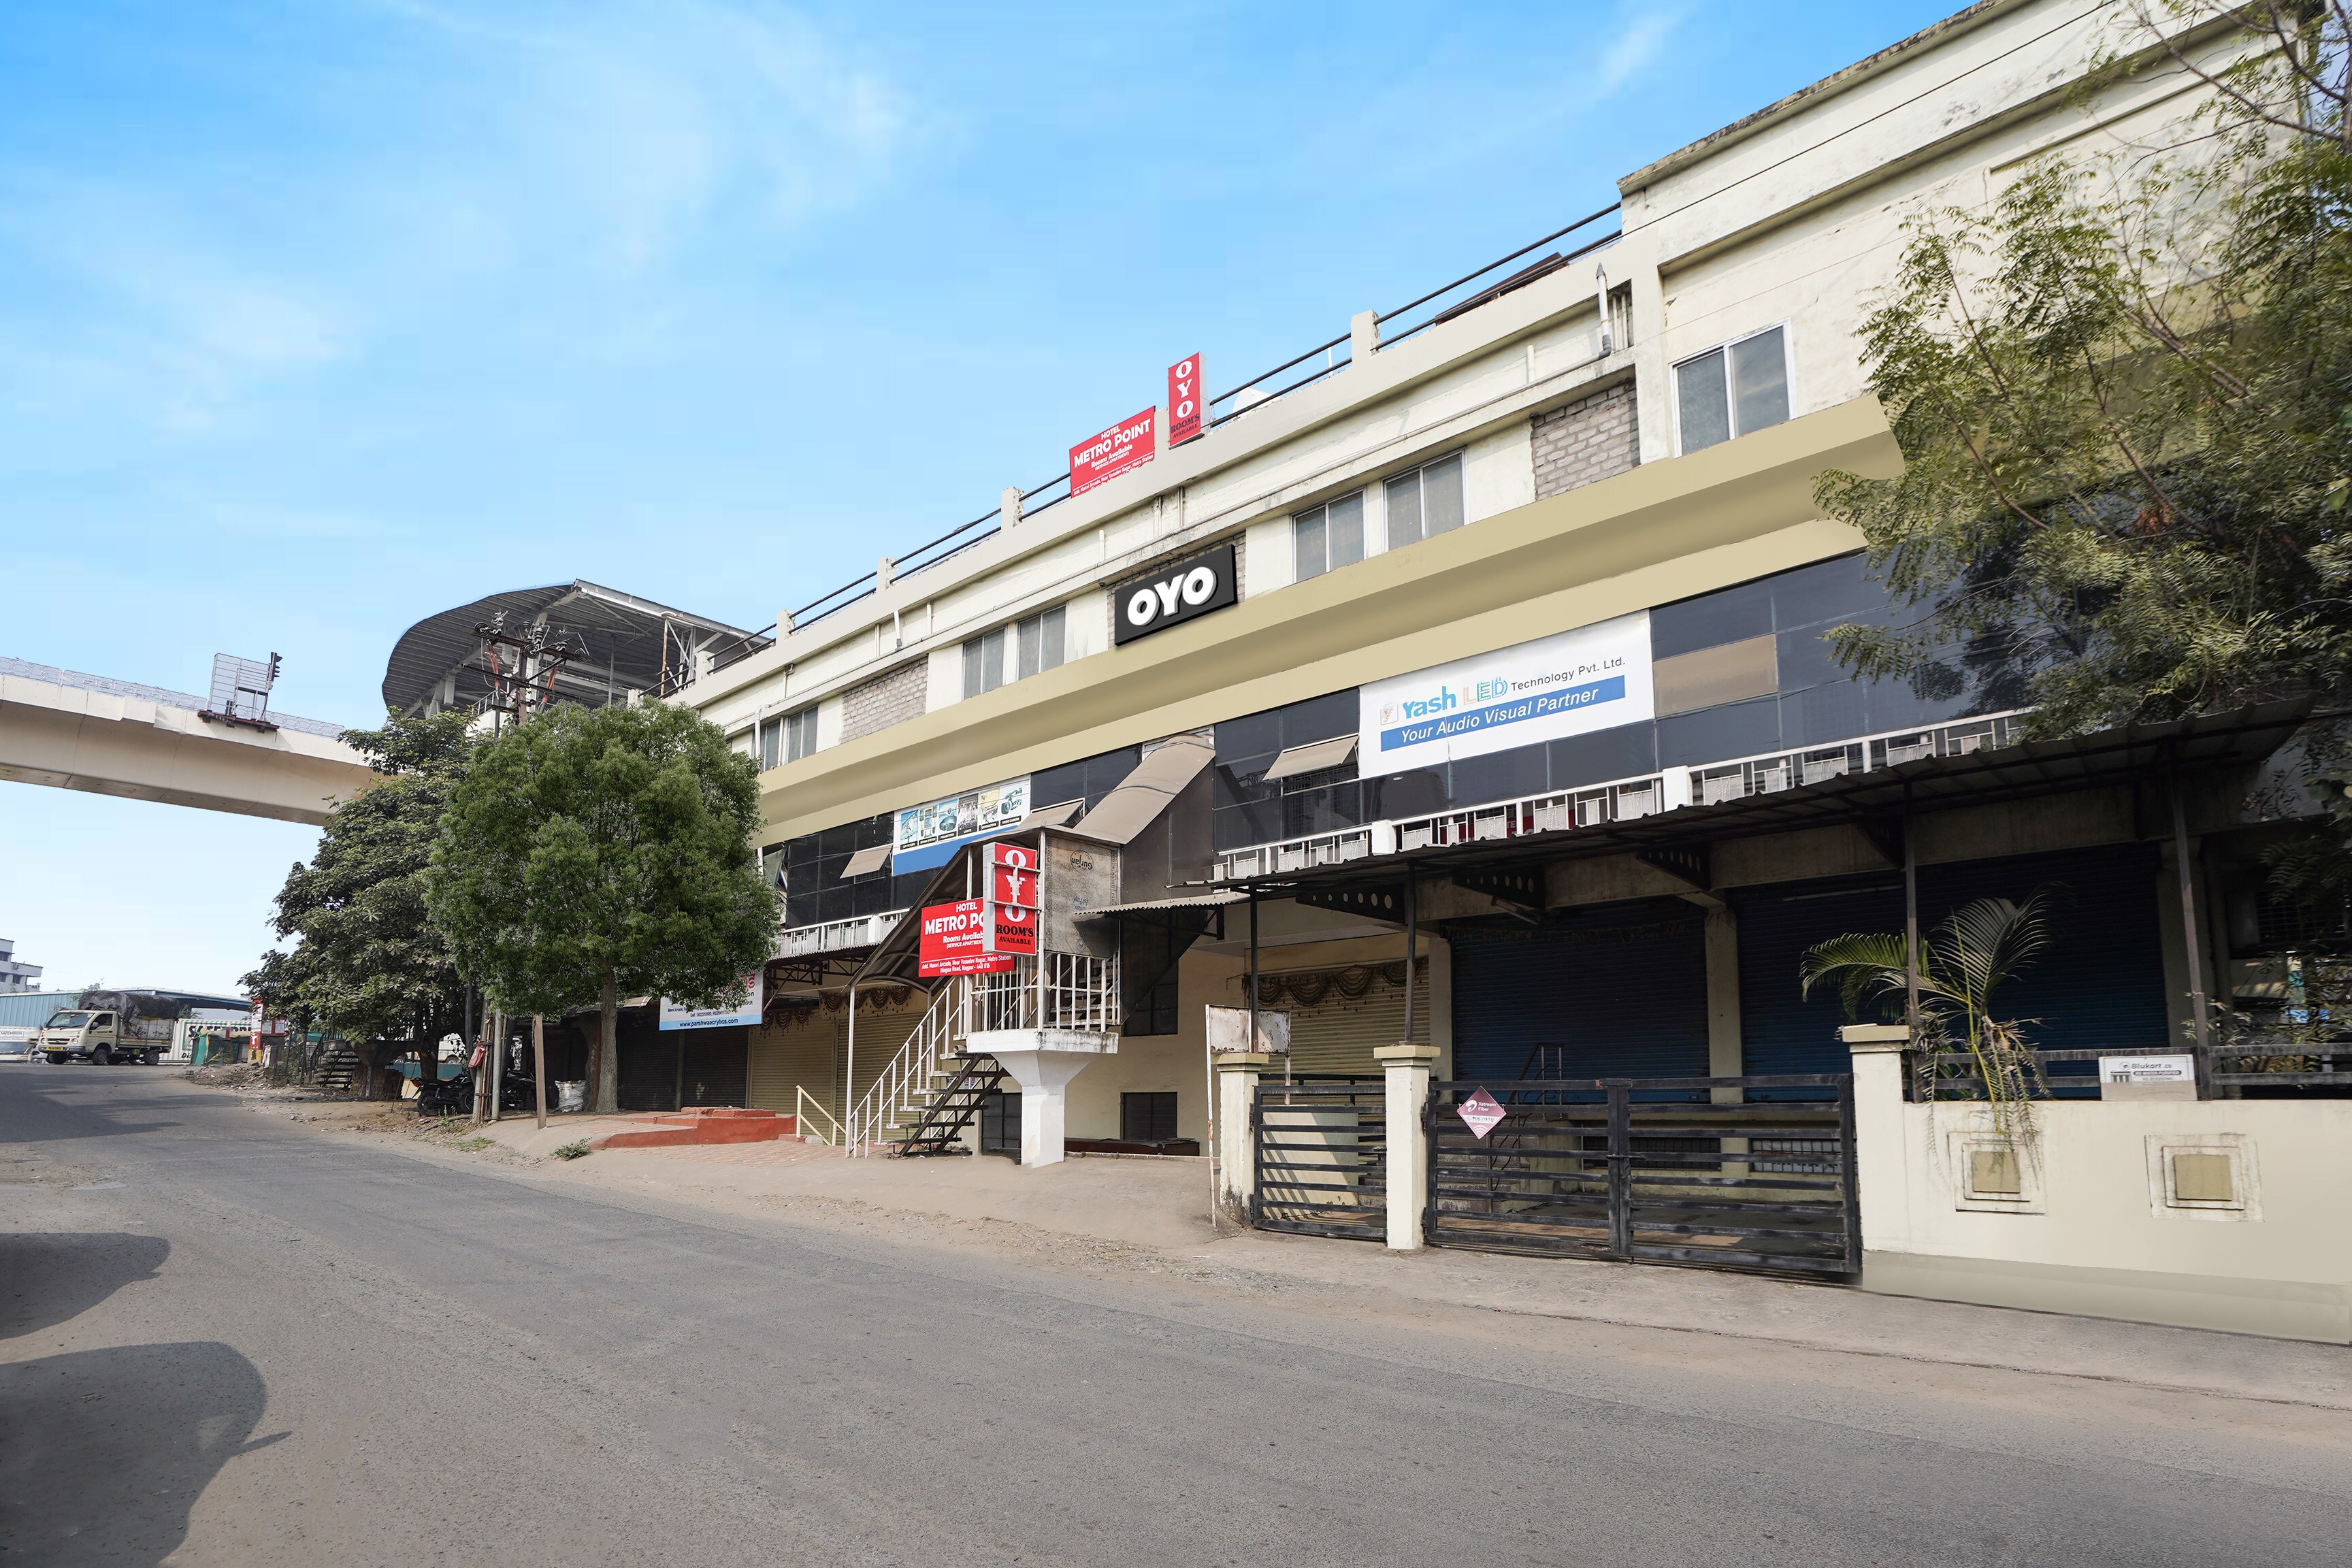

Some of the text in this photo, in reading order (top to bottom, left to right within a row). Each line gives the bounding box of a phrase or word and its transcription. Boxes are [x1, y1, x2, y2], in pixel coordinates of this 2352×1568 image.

[1175, 360, 1194, 419] OYO
[1101, 425, 1120, 440] HOTEL
[1173, 423, 1198, 439] AVAILABLE
[1074, 419, 1151, 468] METRO POINT
[1091, 444, 1133, 468] Rooms Available
[1128, 566, 1218, 626] OYO
[1511, 657, 1626, 691] Technology Pvt. Ltd.
[1403, 676, 1508, 719] Yash LED
[1402, 688, 1599, 743] Your Audio Visual Partner
[1071, 854, 1092, 870] Gurjan
[956, 902, 978, 913] HOTEL
[925, 914, 966, 935] METRO
[996, 924, 1034, 937] ROOM'S
[943, 935, 961, 943] Rooms
[999, 936, 1031, 945] AVAILABLE
